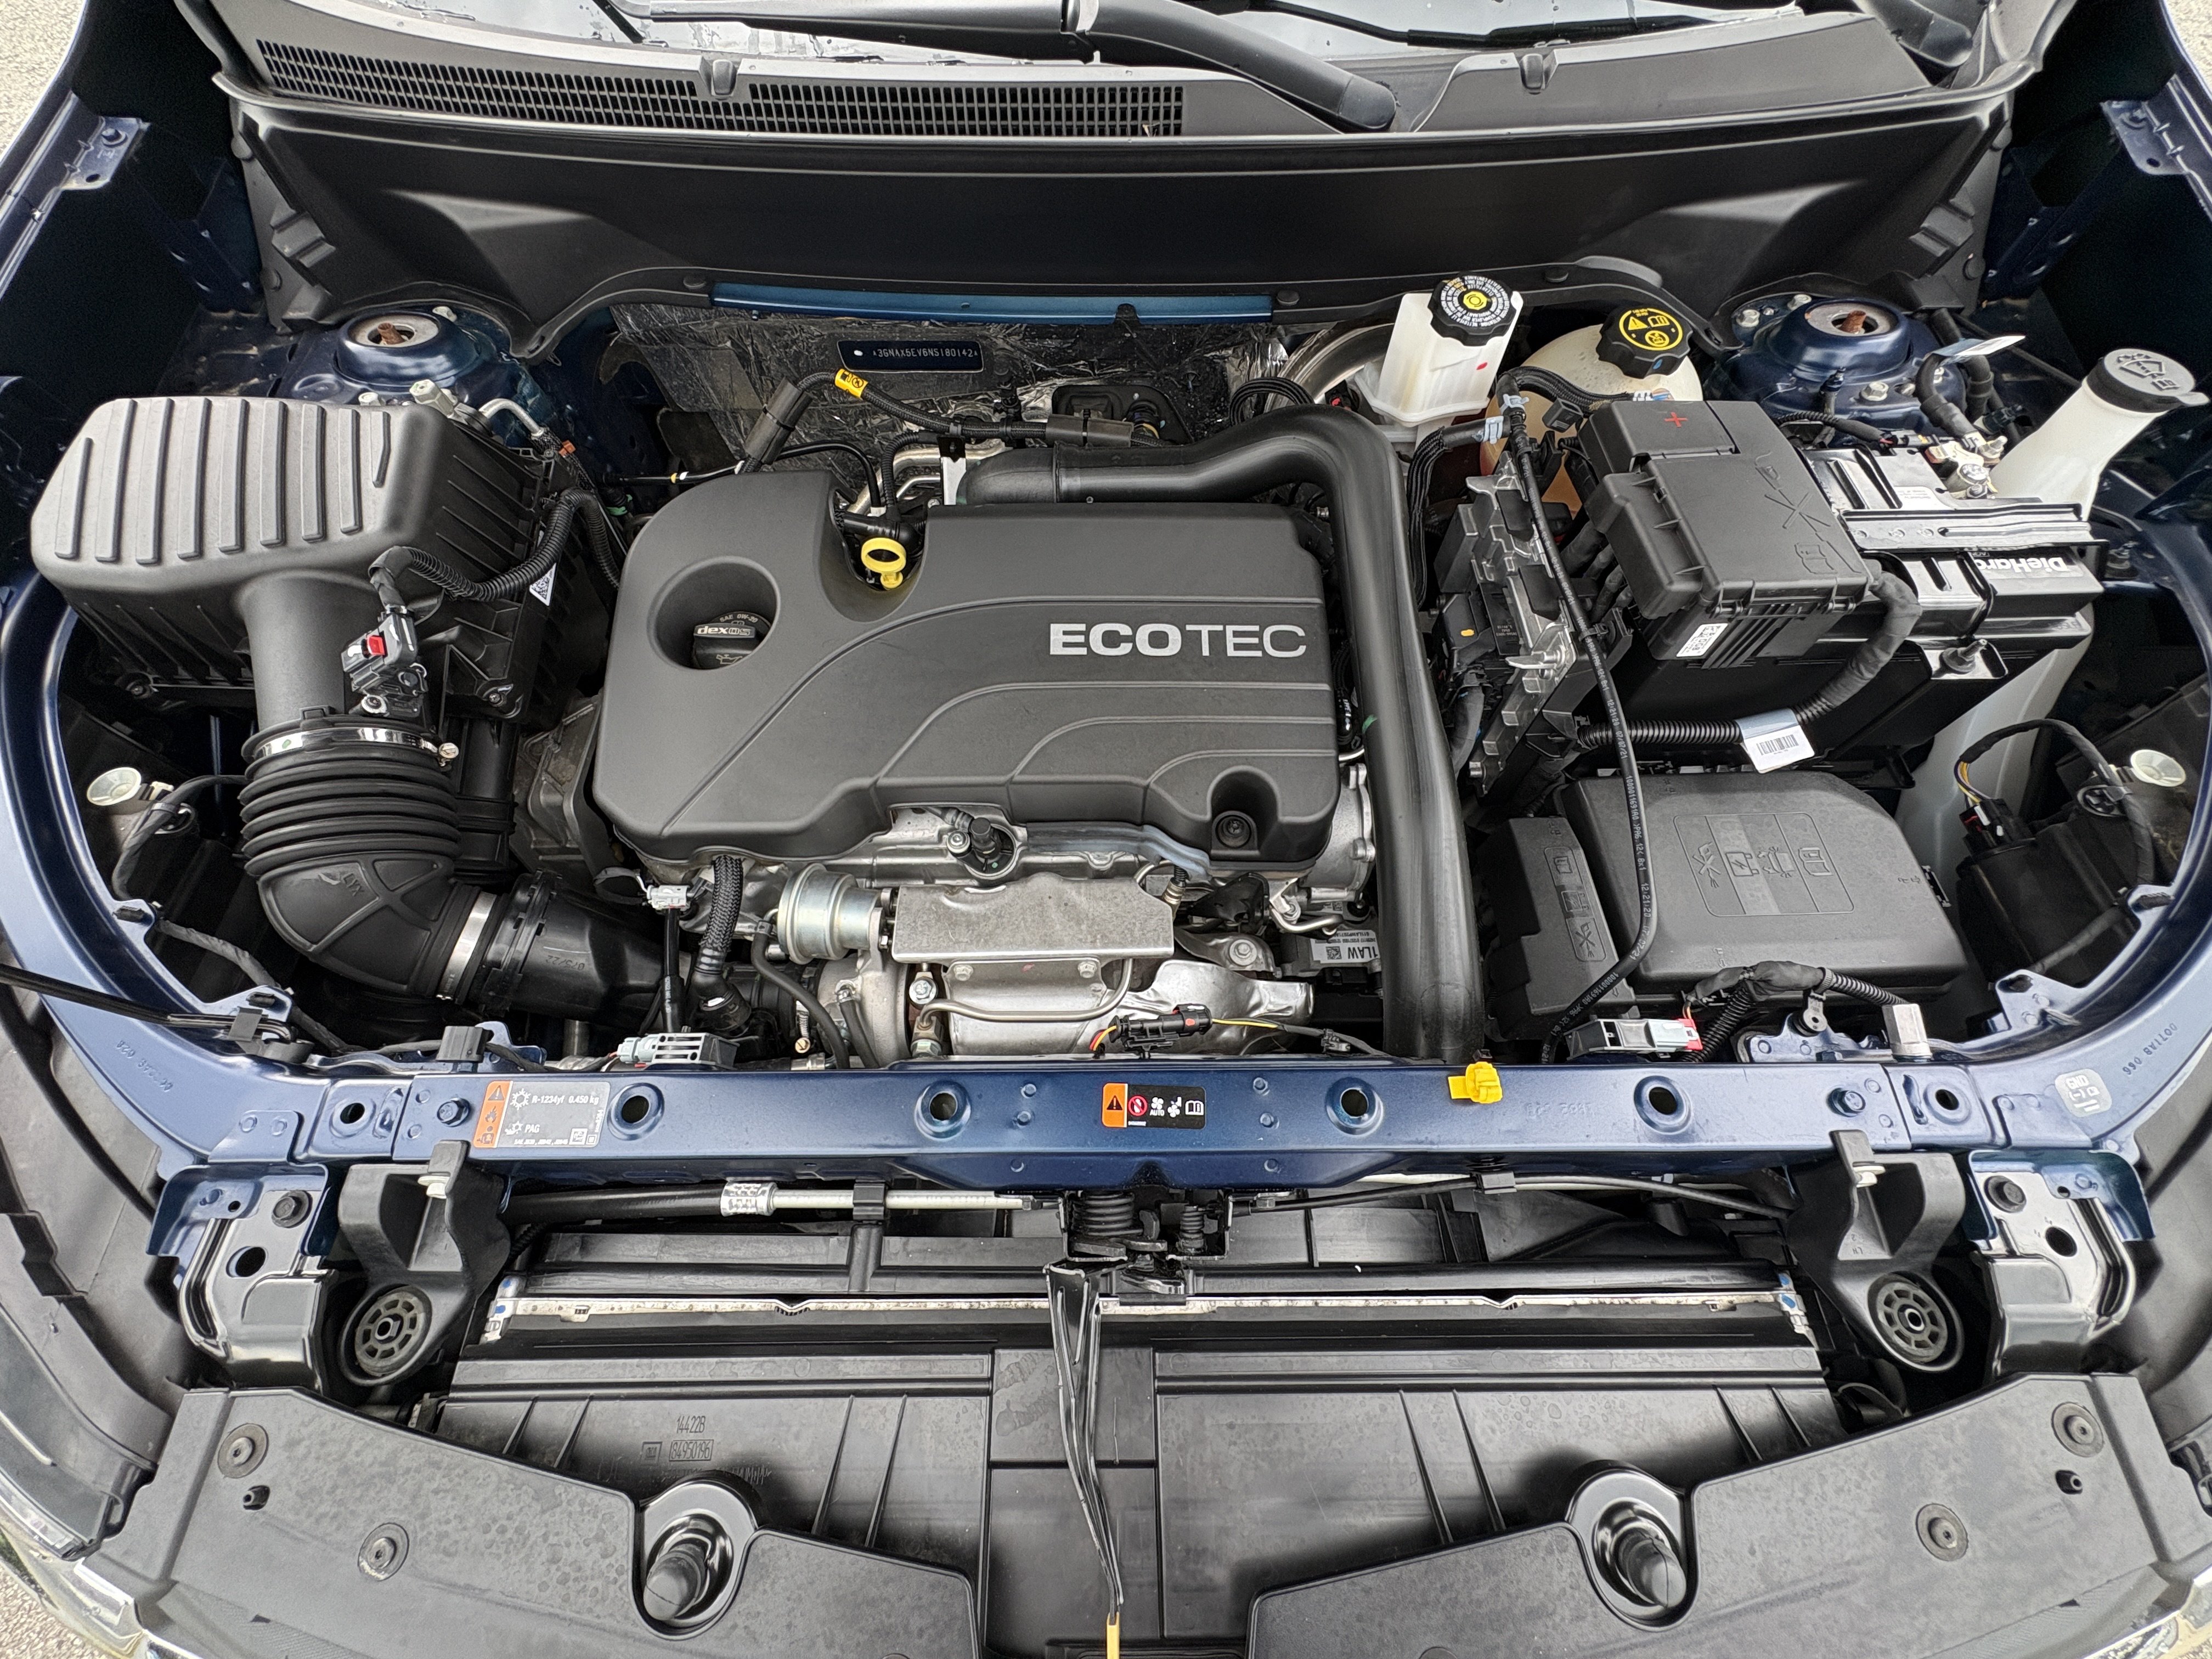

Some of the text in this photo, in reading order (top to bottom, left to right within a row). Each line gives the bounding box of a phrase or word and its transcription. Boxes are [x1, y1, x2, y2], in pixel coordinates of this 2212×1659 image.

[737, 614, 758, 623] 0W-20
[697, 626, 751, 636] dexos
[1050, 623, 1307, 658] ECOTEC
[1347, 946, 1378, 959] 1LAW
[2066, 1075, 2090, 1090] GND
[589, 1095, 600, 1105] kg
[524, 1124, 540, 1133] PAG
